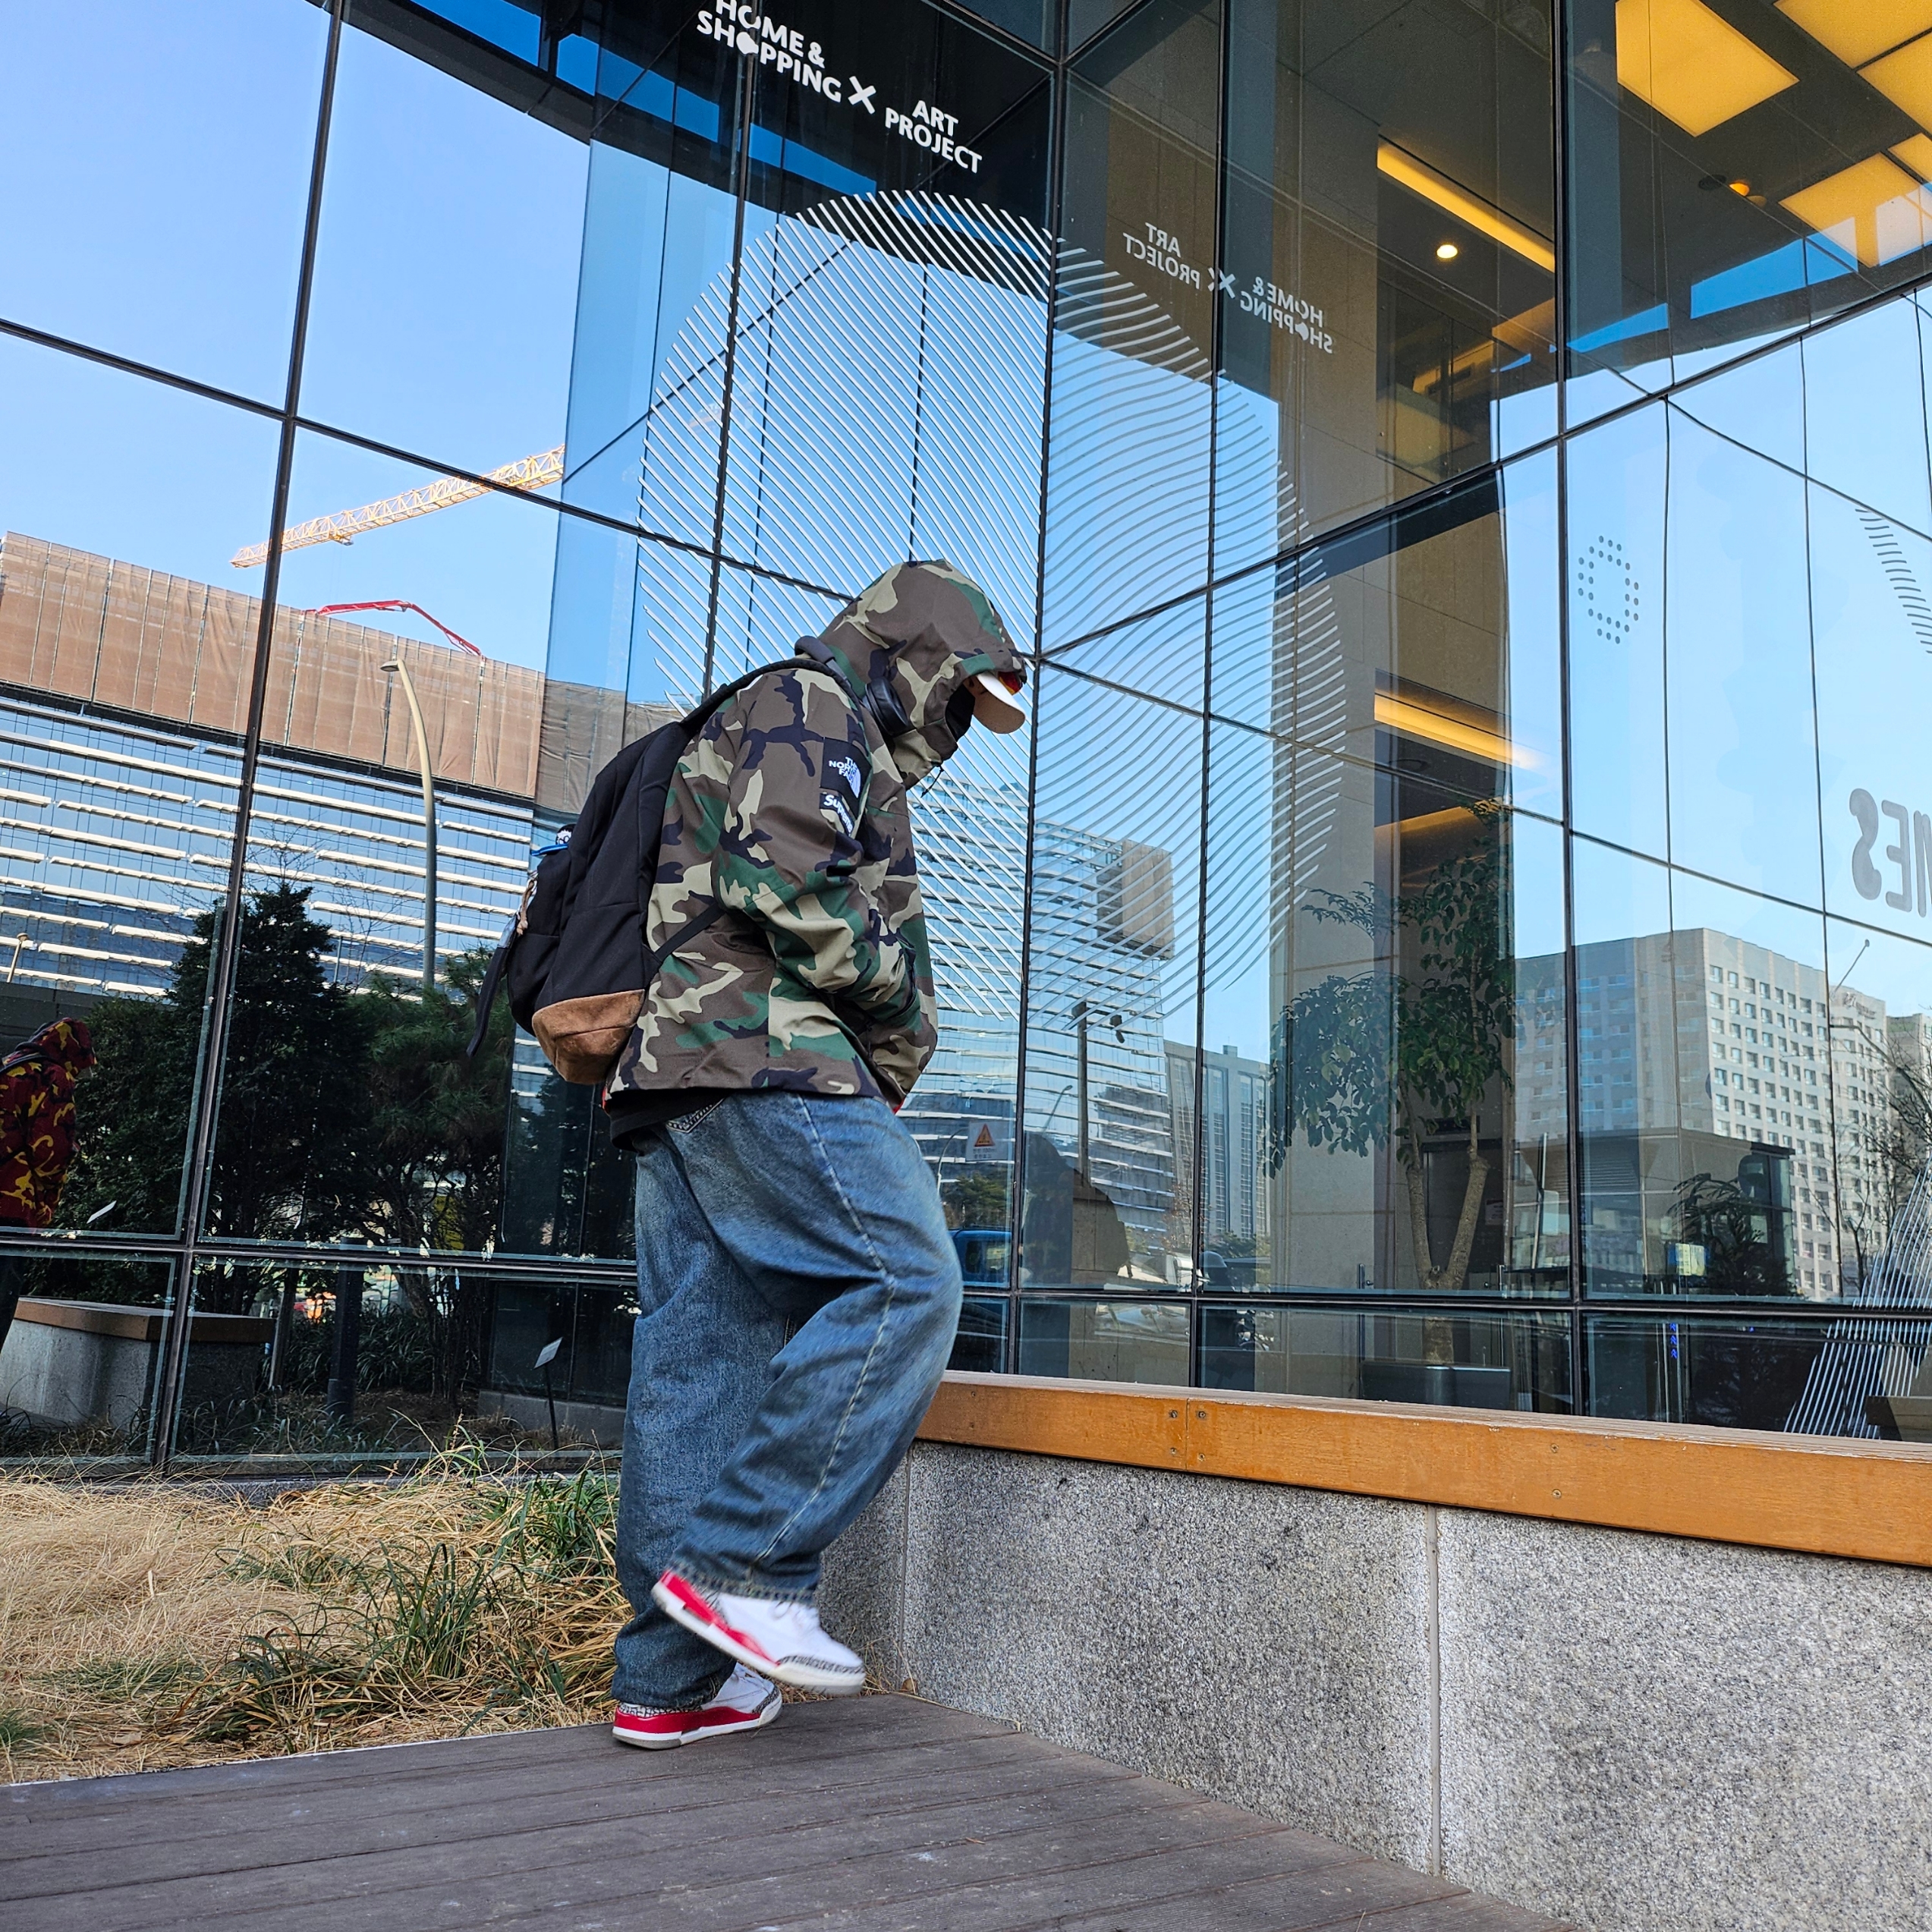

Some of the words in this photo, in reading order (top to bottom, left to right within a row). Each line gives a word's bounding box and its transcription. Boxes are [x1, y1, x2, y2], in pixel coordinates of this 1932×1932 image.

[696, 10, 842, 103] SHOPPING
[715, 0, 804, 58] HOME
[807, 41, 826, 69] &
[884, 106, 983, 174] PROJECT
[911, 99, 959, 137] ART
[823, 794, 854, 834] Supreme
